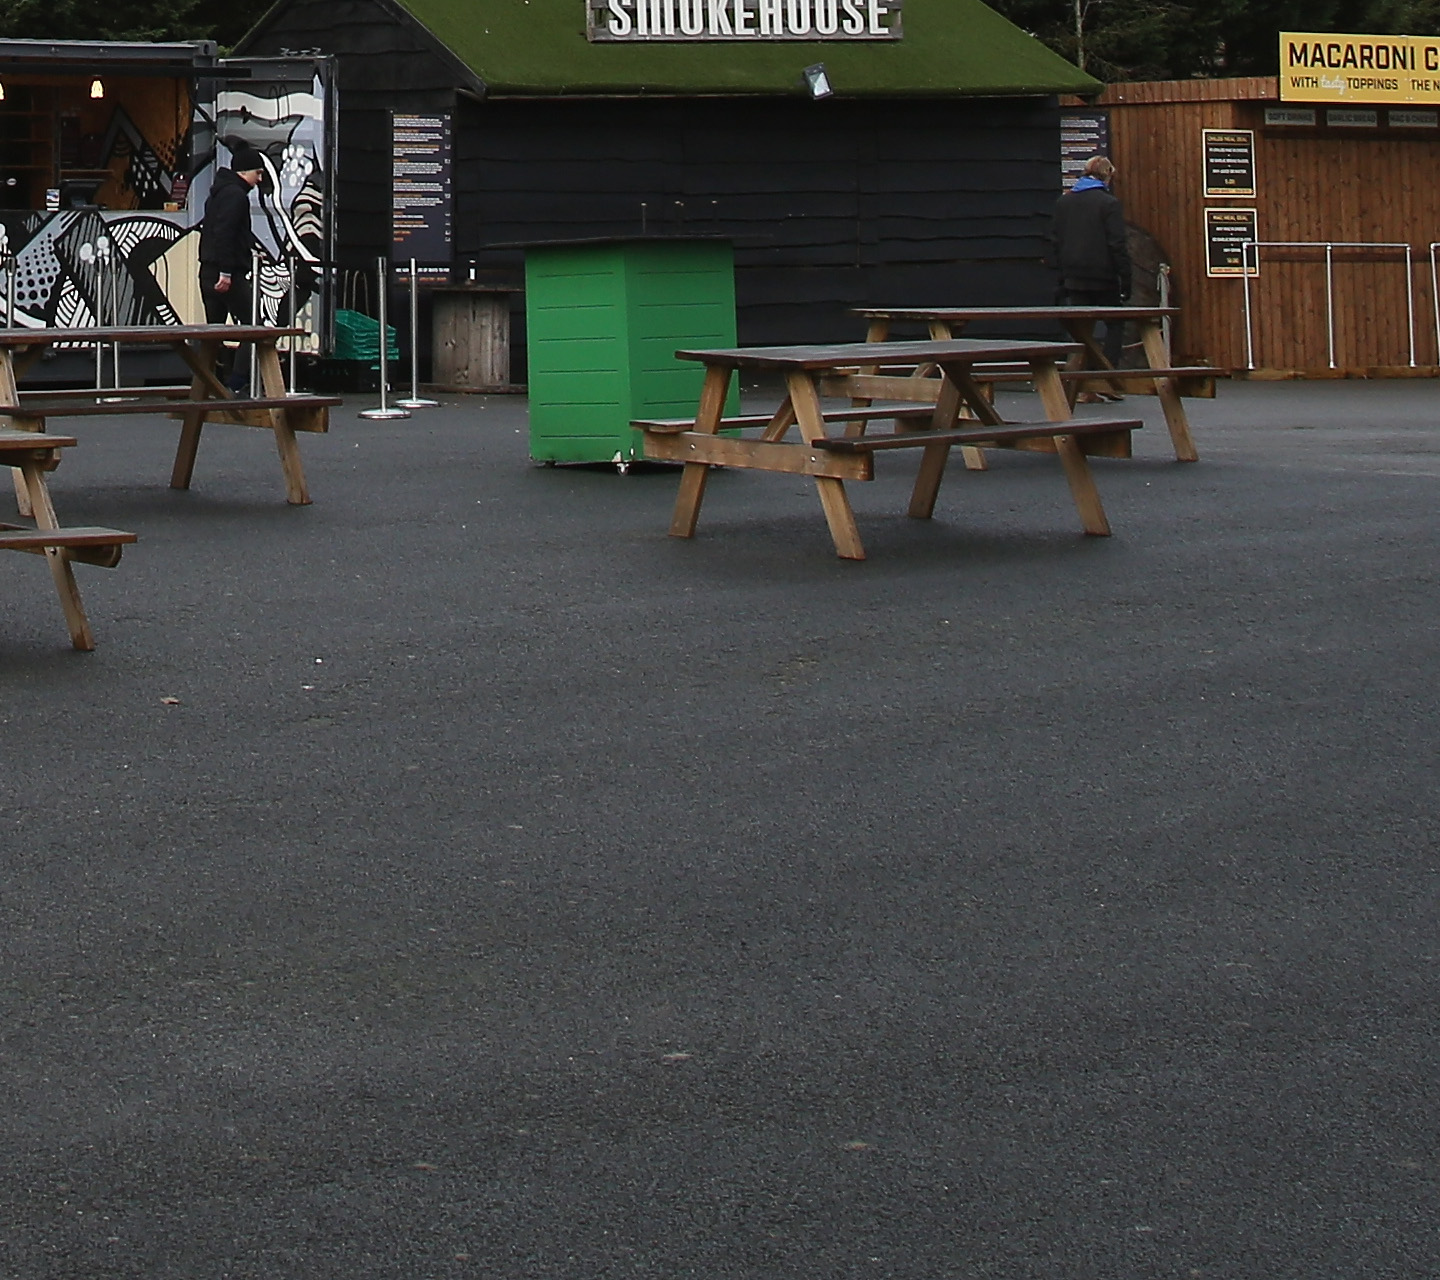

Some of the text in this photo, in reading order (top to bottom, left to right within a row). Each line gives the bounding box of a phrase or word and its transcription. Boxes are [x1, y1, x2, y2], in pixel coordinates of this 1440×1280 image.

[1288, 42, 1415, 70] MACARONI
[1291, 76, 1319, 89] WITH
[1346, 77, 1399, 90] TOPPINGS
[1411, 78, 1432, 91] THE
